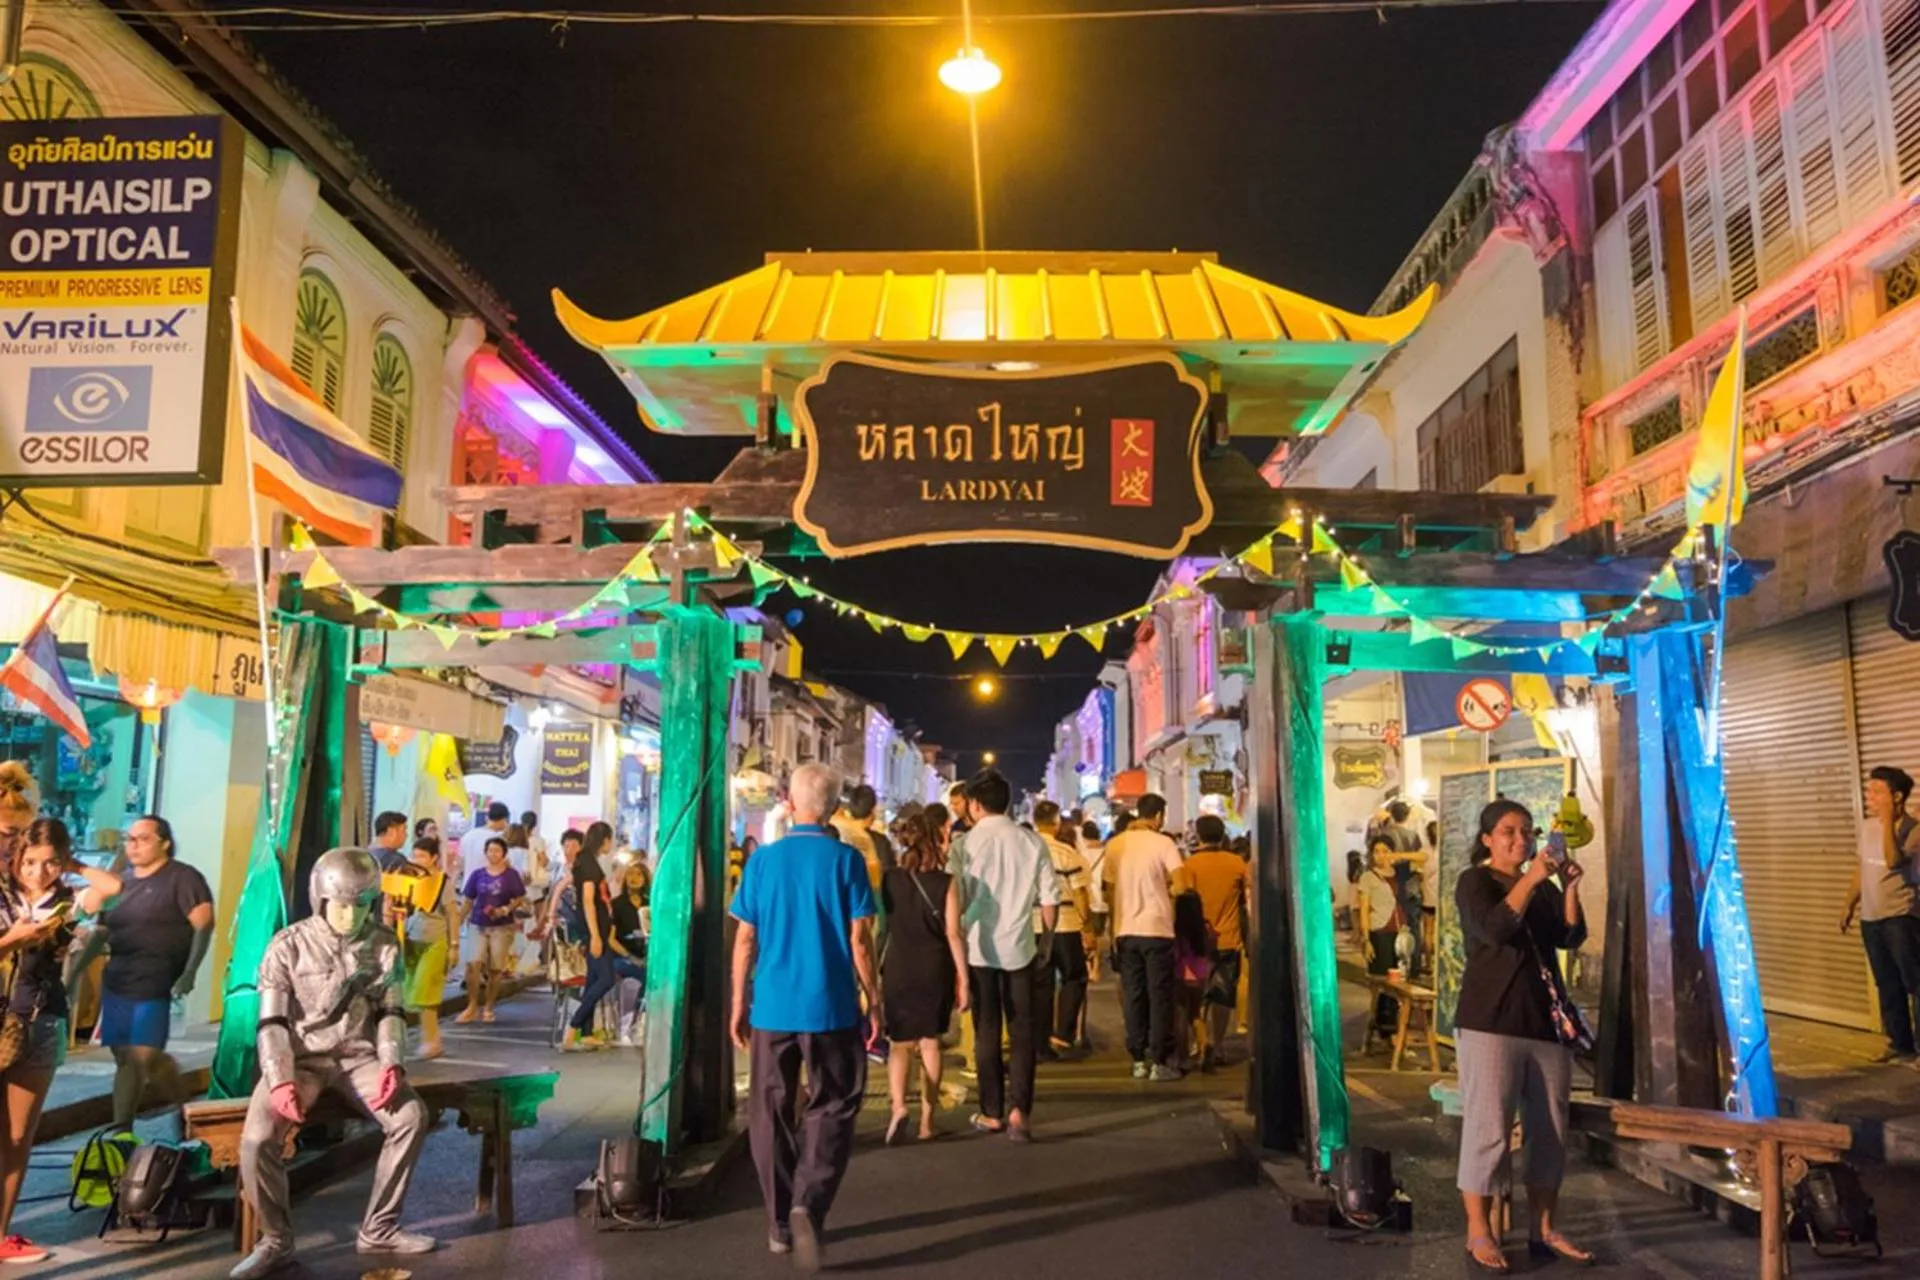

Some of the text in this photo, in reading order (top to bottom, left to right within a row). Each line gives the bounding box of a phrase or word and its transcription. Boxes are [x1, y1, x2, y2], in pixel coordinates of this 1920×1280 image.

[8, 132, 214, 170] อุทัยศิลป์การแว่น
[2, 177, 212, 216] UTHAISILP
[10, 226, 190, 262] OPTICAL
[0, 276, 203, 298] PREMIUM PROGRESSIVE LENS
[0, 342, 58, 355] Natural
[130, 340, 193, 352] Forever.
[920, 479, 1045, 502] LARDYAI
